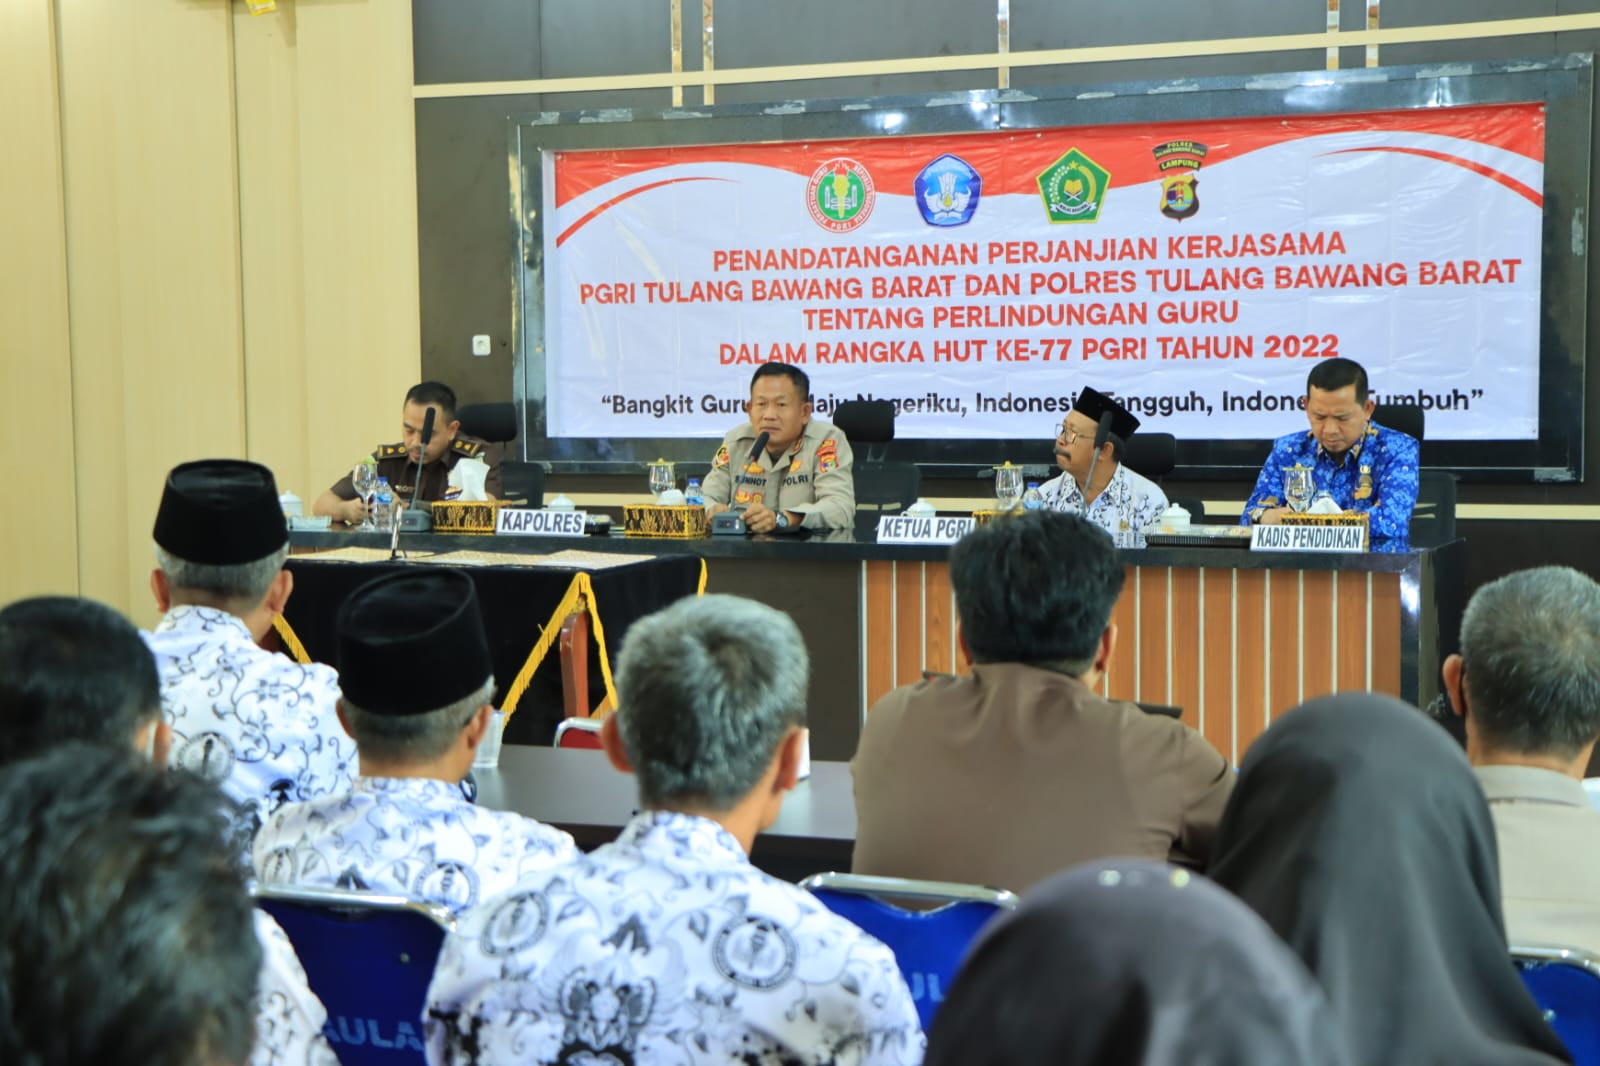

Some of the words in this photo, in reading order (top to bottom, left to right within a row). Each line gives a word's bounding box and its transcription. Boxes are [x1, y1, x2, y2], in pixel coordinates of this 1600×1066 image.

[1161, 159, 1199, 170] LAMPUNG
[714, 244, 978, 272] PENANDATANGANAN
[988, 238, 1158, 264] PERJANJIAN
[1169, 232, 1346, 259] KERJASAMA
[581, 284, 635, 304] PGRI
[644, 281, 744, 303] TULANG
[752, 278, 863, 301] BAWANG
[873, 275, 956, 299] BARAT
[965, 274, 1021, 297] DAN
[1031, 271, 1137, 295] POLRES
[1147, 267, 1264, 292] TULANG
[1276, 263, 1408, 289] BAWANG
[1419, 259, 1522, 285] BARAT
[804, 307, 924, 331] TENTANG
[933, 303, 1148, 328] PERLINDUNGAN
[1158, 301, 1239, 324] GURU
[720, 343, 807, 365] DALAM
[816, 341, 925, 364] RANGKA
[934, 340, 988, 362] HUT
[997, 339, 1073, 362] KE-77
[1083, 338, 1147, 361] PGRI
[1157, 336, 1254, 360] TAHUN
[1264, 334, 1339, 358] 2022
[976, 391, 1077, 413] Indonesi
[1222, 390, 1306, 412] Indone
[782, 474, 809, 487] POLRI
[502, 511, 582, 533] KAPOLRES
[882, 518, 931, 538] KETUA
[1257, 526, 1291, 548] KADIS
[1292, 527, 1361, 549] PENDIDIKAN
